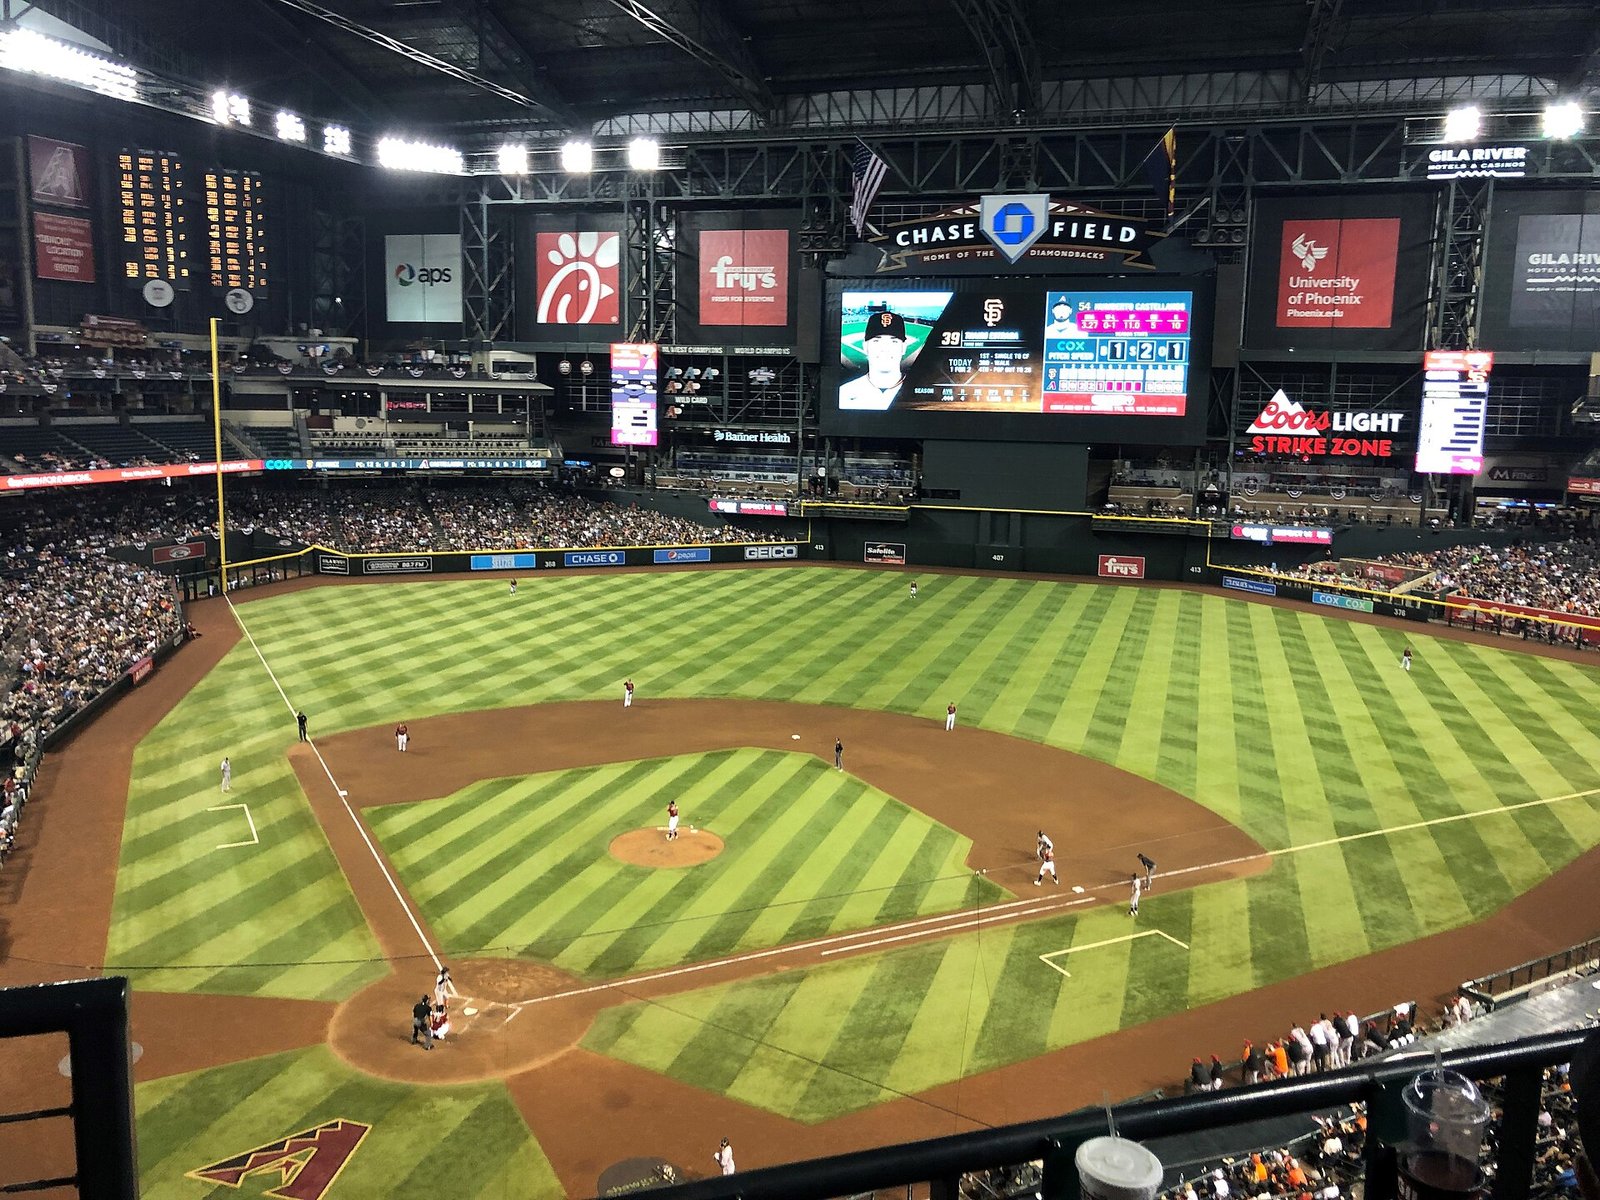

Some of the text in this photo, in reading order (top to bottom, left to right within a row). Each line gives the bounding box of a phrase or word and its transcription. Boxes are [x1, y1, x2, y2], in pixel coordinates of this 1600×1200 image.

[1429, 147, 1526, 162] GILA RIVER
[896, 222, 1136, 246] CHASE FIELD
[924, 253, 950, 262] HOME
[1030, 250, 1105, 260] DIAMONDBACKS
[1528, 254, 1570, 264] GILA
[418, 268, 452, 286] aps
[710, 256, 778, 291] fry's
[1289, 276, 1360, 291] University
[1288, 292, 1361, 304] of Phoenix
[1078, 302, 1091, 310] 54
[1286, 309, 1344, 317] Phoenix.edu
[941, 332, 960, 346] 39
[1057, 341, 1085, 351] COX
[1114, 343, 1122, 358] 1
[1140, 343, 1153, 358] 2
[1172, 343, 1180, 359] 1
[1254, 402, 1404, 432] Coors LIGHT
[725, 432, 790, 443] Banner Health
[1252, 436, 1392, 456] STRIKE ZONE
[266, 460, 292, 470] COX
[572, 554, 607, 564] CHASE
[745, 548, 798, 560] GEICO
[1104, 558, 1138, 575] fry's
[1320, 594, 1366, 610] COX COX
